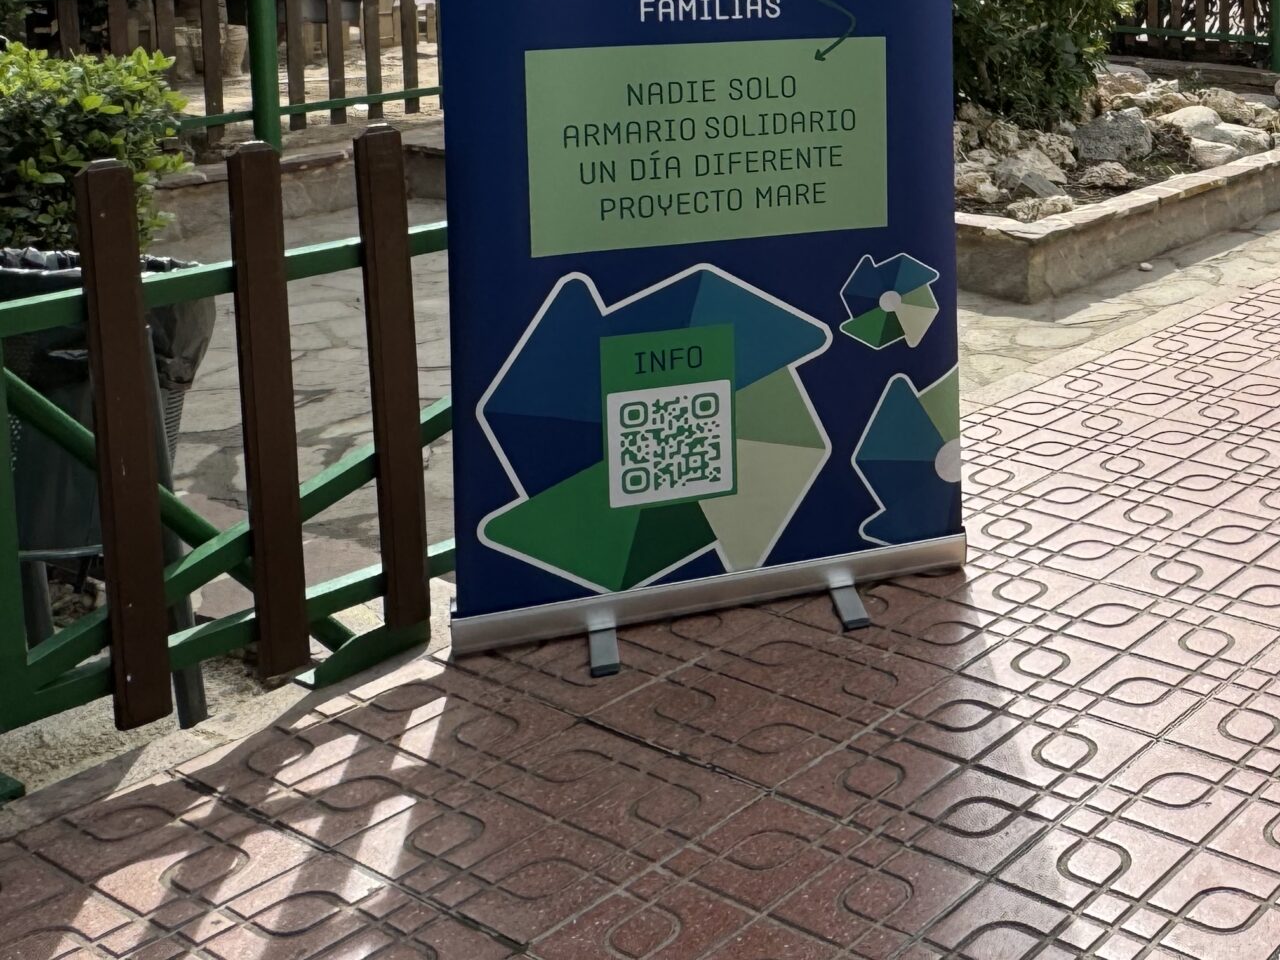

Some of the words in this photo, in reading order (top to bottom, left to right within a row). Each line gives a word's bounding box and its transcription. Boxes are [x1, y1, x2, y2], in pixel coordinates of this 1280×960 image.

[626, 78, 717, 107] NADIE
[728, 75, 797, 101] SOLO
[563, 116, 696, 149] ARMARIO
[704, 108, 857, 140] SOLIDARIO
[579, 159, 616, 185] UN
[630, 150, 681, 182] DÍA
[694, 145, 844, 179] DIFERENTE
[599, 187, 743, 222] PROYECTO
[755, 182, 827, 209] MARE
[634, 345, 703, 375] INFO
